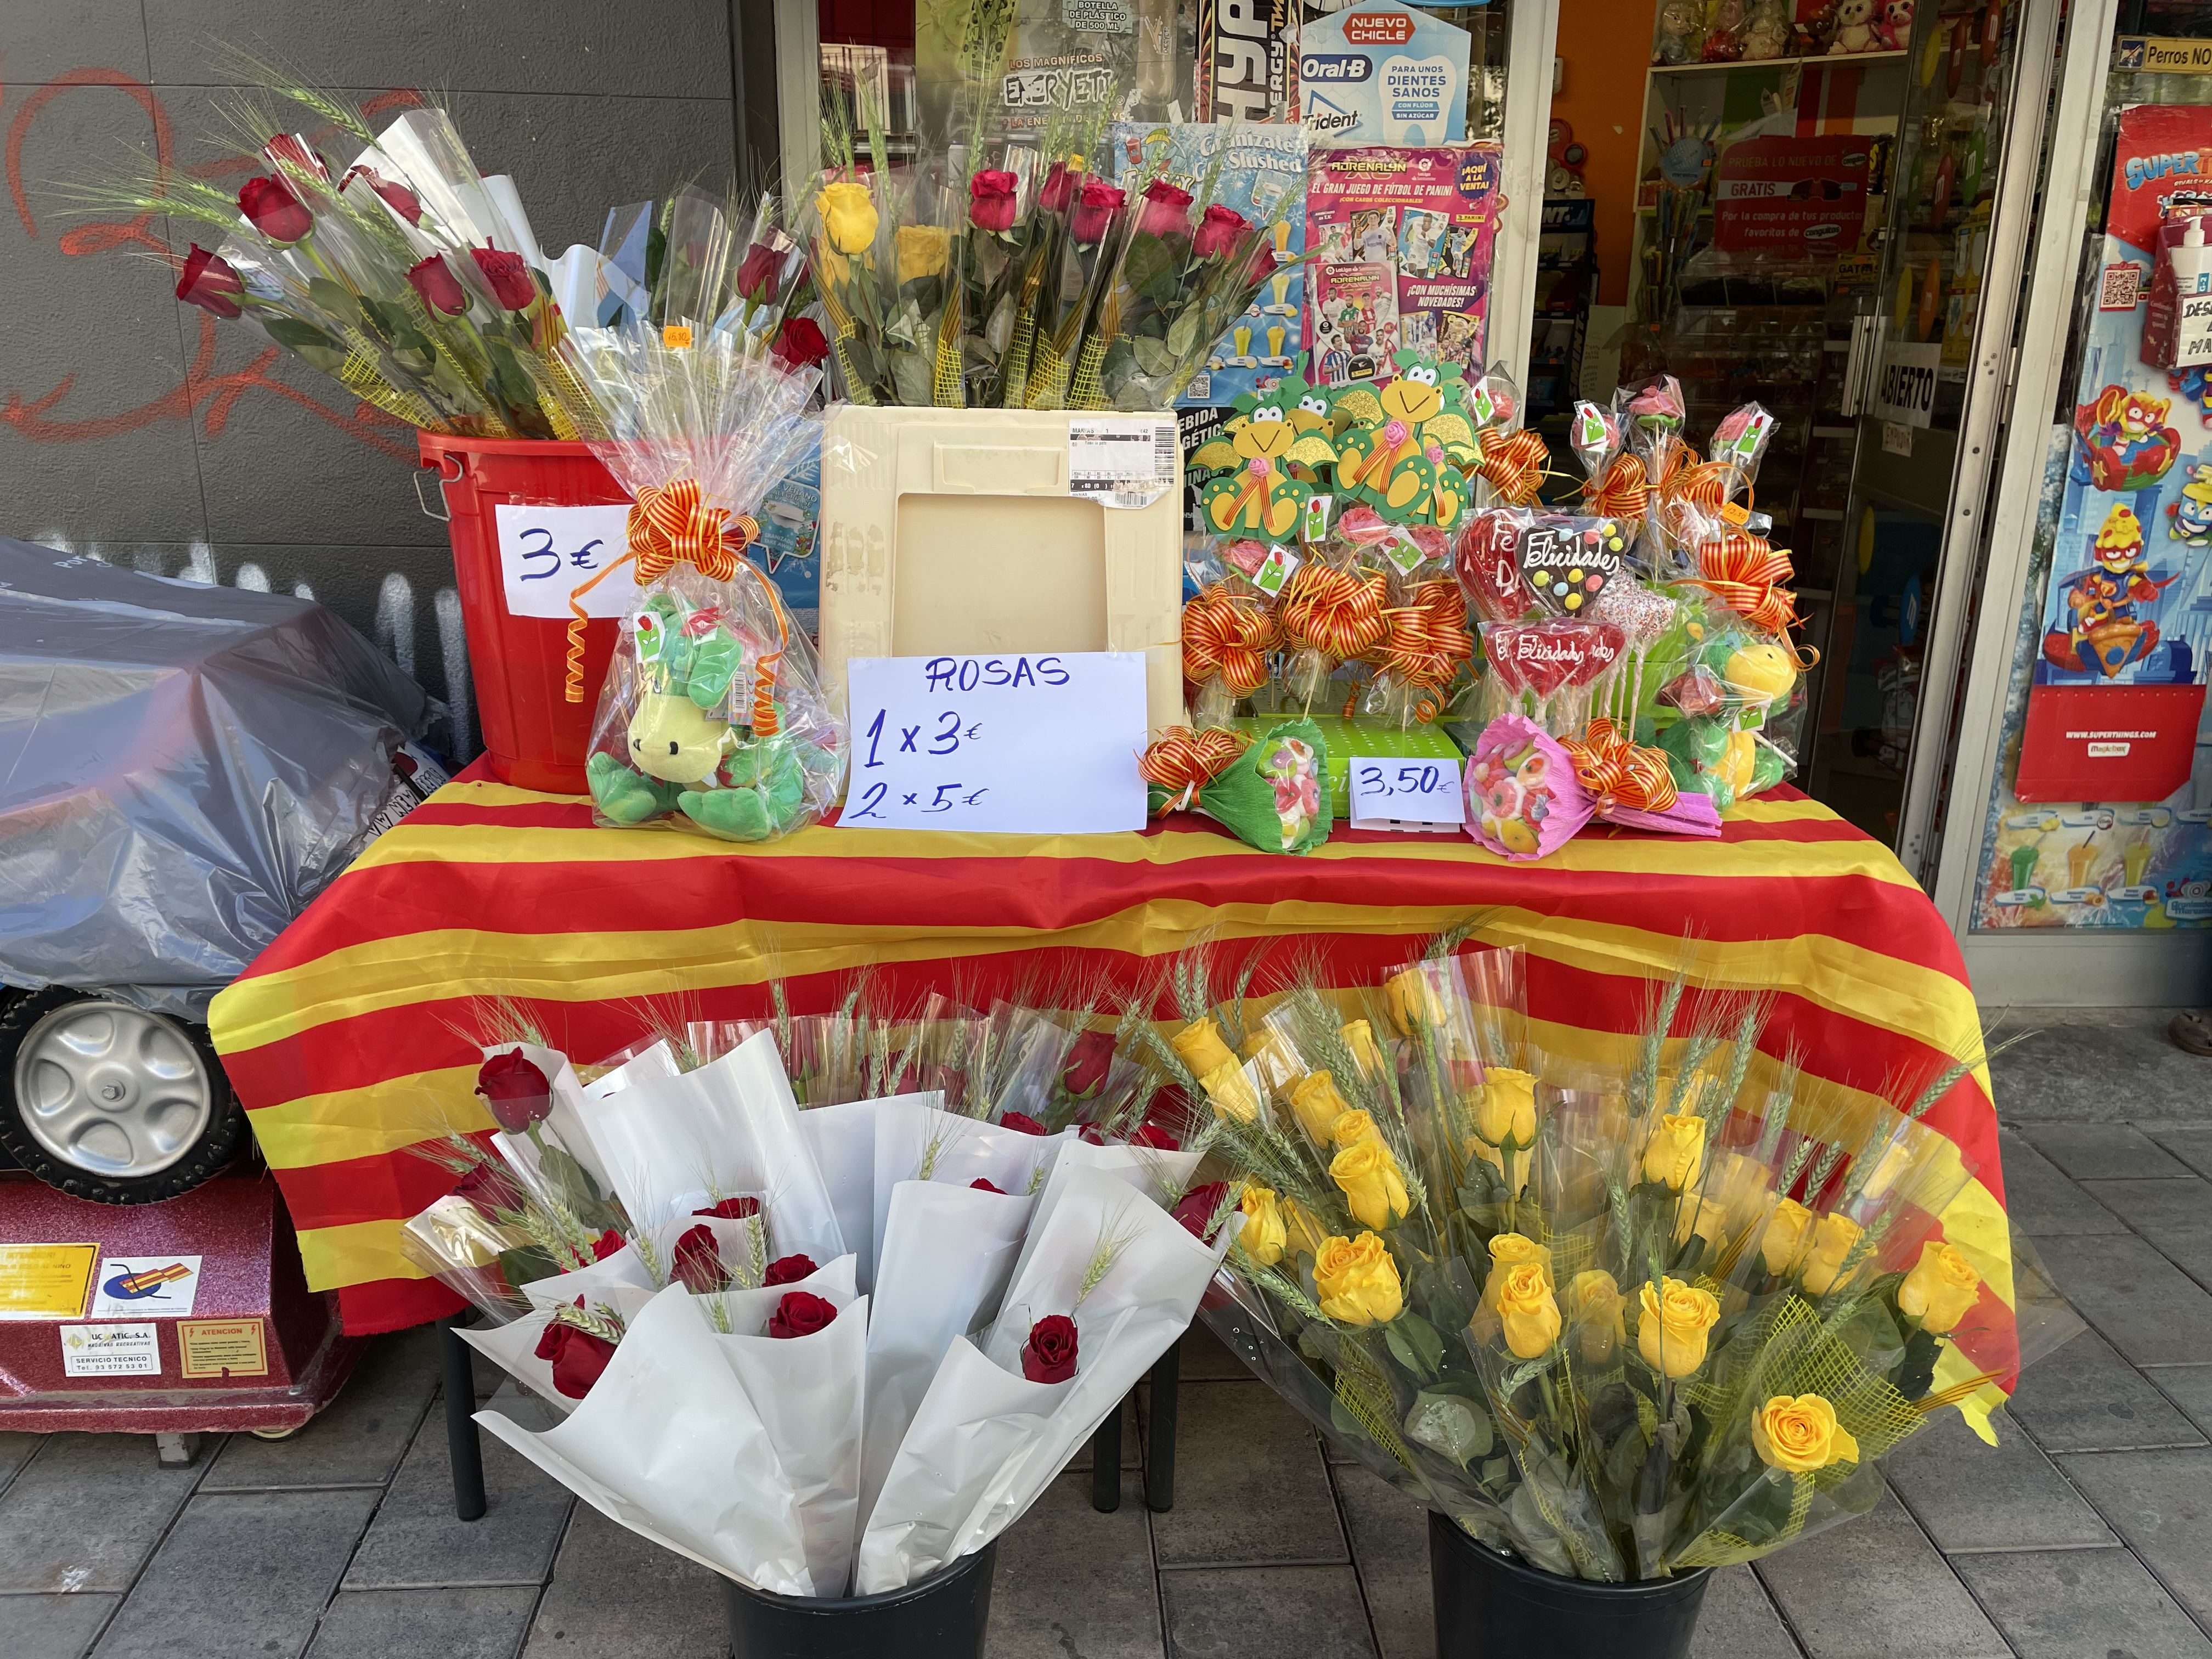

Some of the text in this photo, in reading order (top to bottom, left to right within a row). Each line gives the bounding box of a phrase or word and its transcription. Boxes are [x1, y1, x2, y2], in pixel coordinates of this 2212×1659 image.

[1078, 1, 1118, 10] BOTELLA
[1069, 10, 1126, 21] DE PLÁSTICO
[1075, 21, 1120, 31] DE 500 ML
[1351, 18, 1407, 28] NUEVO
[1351, 30, 1406, 40] CHICLE
[2147, 46, 2211, 65] Perros NO
[1009, 58, 1030, 69] LOS
[1302, 58, 1367, 78] Oral-B
[1387, 76, 1446, 86] DIENTES
[1392, 88, 1440, 98] SANOS
[1302, 110, 1358, 131] Trident
[1228, 151, 1302, 173] Slushed
[1330, 162, 1407, 172] ADRENALYN
[1729, 156, 1769, 167] PRUEBA
[1771, 156, 1784, 167] LO
[1788, 155, 1822, 166] NUEVO
[1824, 155, 1837, 165] DE
[1312, 182, 1453, 196] EL GRAN JUEGO DE FÚTBOL DE PANINI
[1731, 183, 1776, 196] GRATIS
[1722, 211, 1864, 224] Por la compra de tus productos
[1744, 227, 1786, 238] favoritos
[1788, 227, 1800, 237] de
[1330, 275, 1380, 284] ADRENALYN
[1427, 283, 1476, 296] MUCHÍSIMAS
[1417, 296, 1464, 308] NOVEDADES!
[1881, 364, 1934, 411] ABIERTO
[1182, 422, 1225, 450] GÉTIC
[783, 484, 817, 503] VERANO
[764, 532, 794, 546] GRANIZADO
[777, 541, 793, 550] AWAY
[1523, 530, 1620, 575] Felicidades
[925, 657, 1070, 692] ROSAS
[864, 708, 887, 769] 1
[2066, 731, 2157, 739] WWW.SUPERTHINGS.COM
[848, 782, 888, 819] 2
[369, 811, 394, 837] VW
[386, 789, 420, 818] NEW
